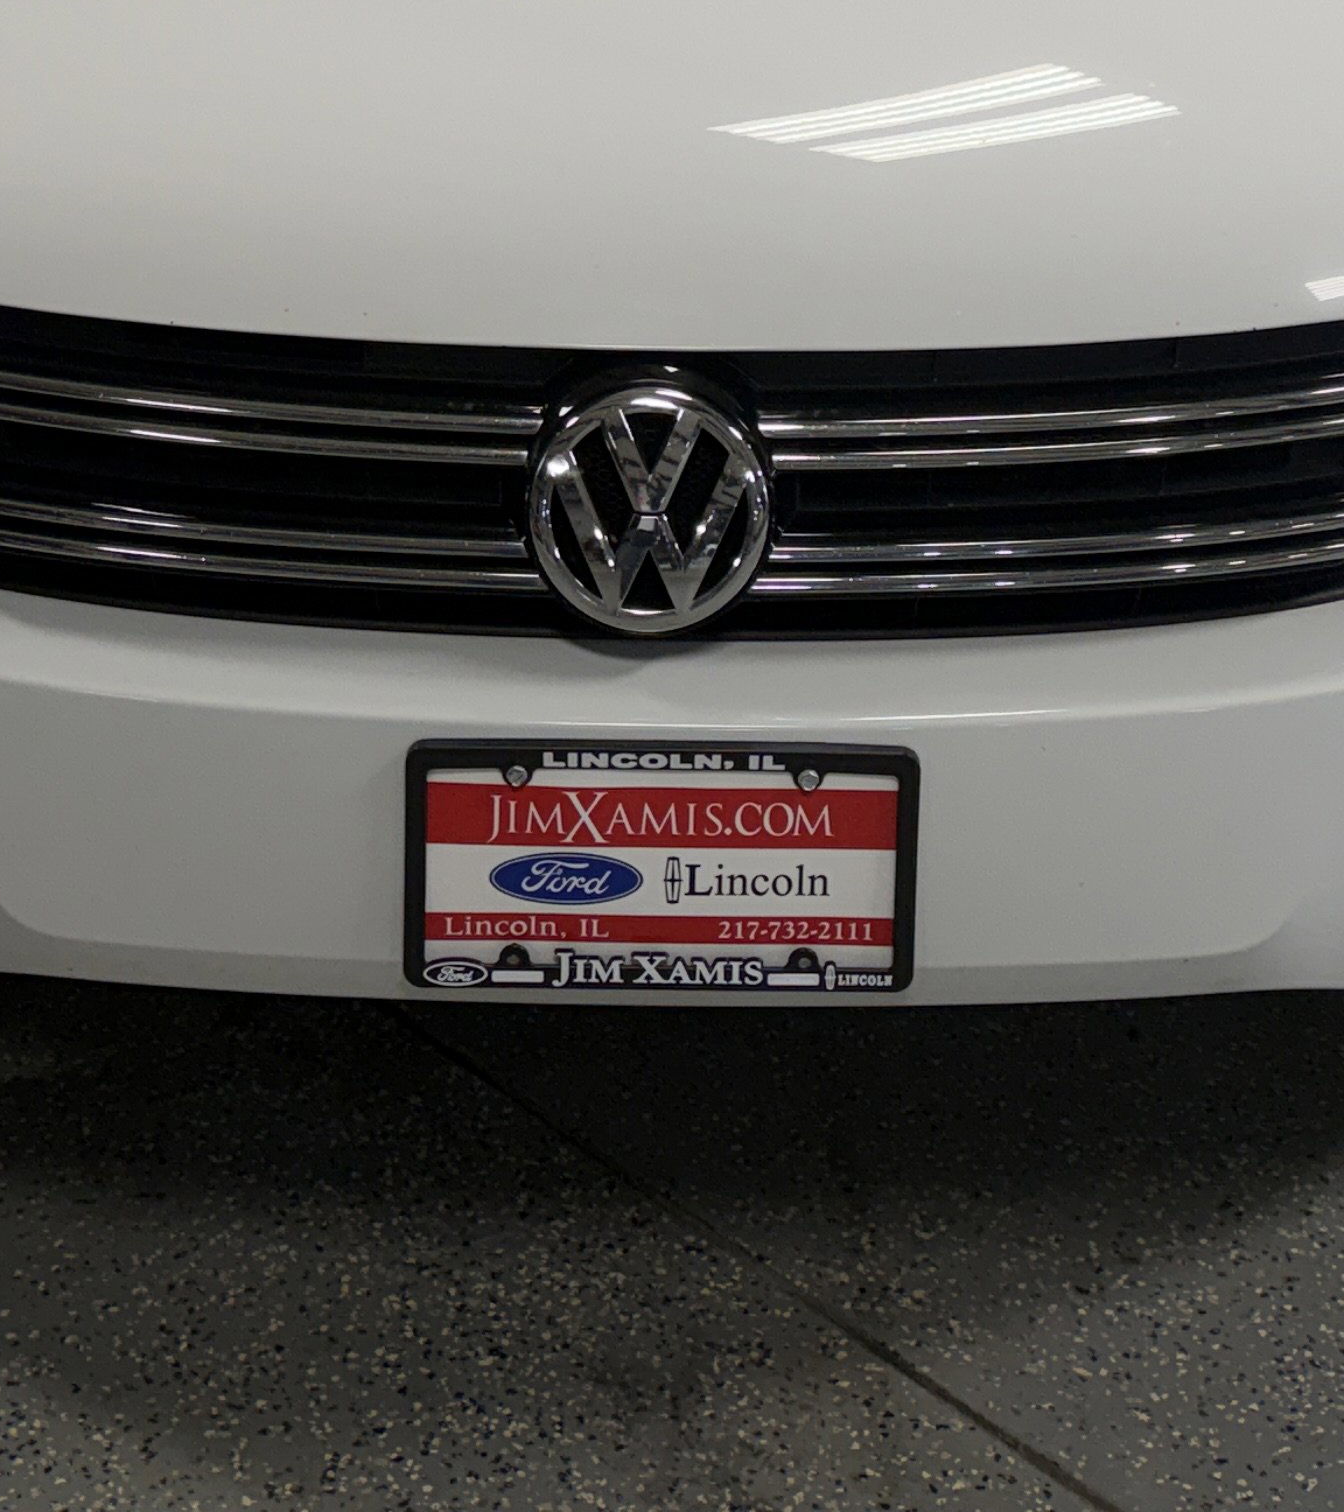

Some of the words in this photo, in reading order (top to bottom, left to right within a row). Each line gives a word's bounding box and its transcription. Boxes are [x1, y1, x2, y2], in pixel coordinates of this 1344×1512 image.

[542, 752, 735, 771] LINCOLN,
[748, 754, 785, 771] IL
[487, 791, 834, 843] JIMXAMIS.COM
[521, 859, 612, 896] Ford
[684, 863, 829, 897] Lincoln
[444, 915, 567, 939] Lincoln,
[579, 919, 609, 938] IL
[719, 920, 873, 941] 217-732-2111
[552, 951, 623, 987] JIM
[633, 956, 764, 987] XAMIS
[837, 973, 893, 987] LINCOLN
